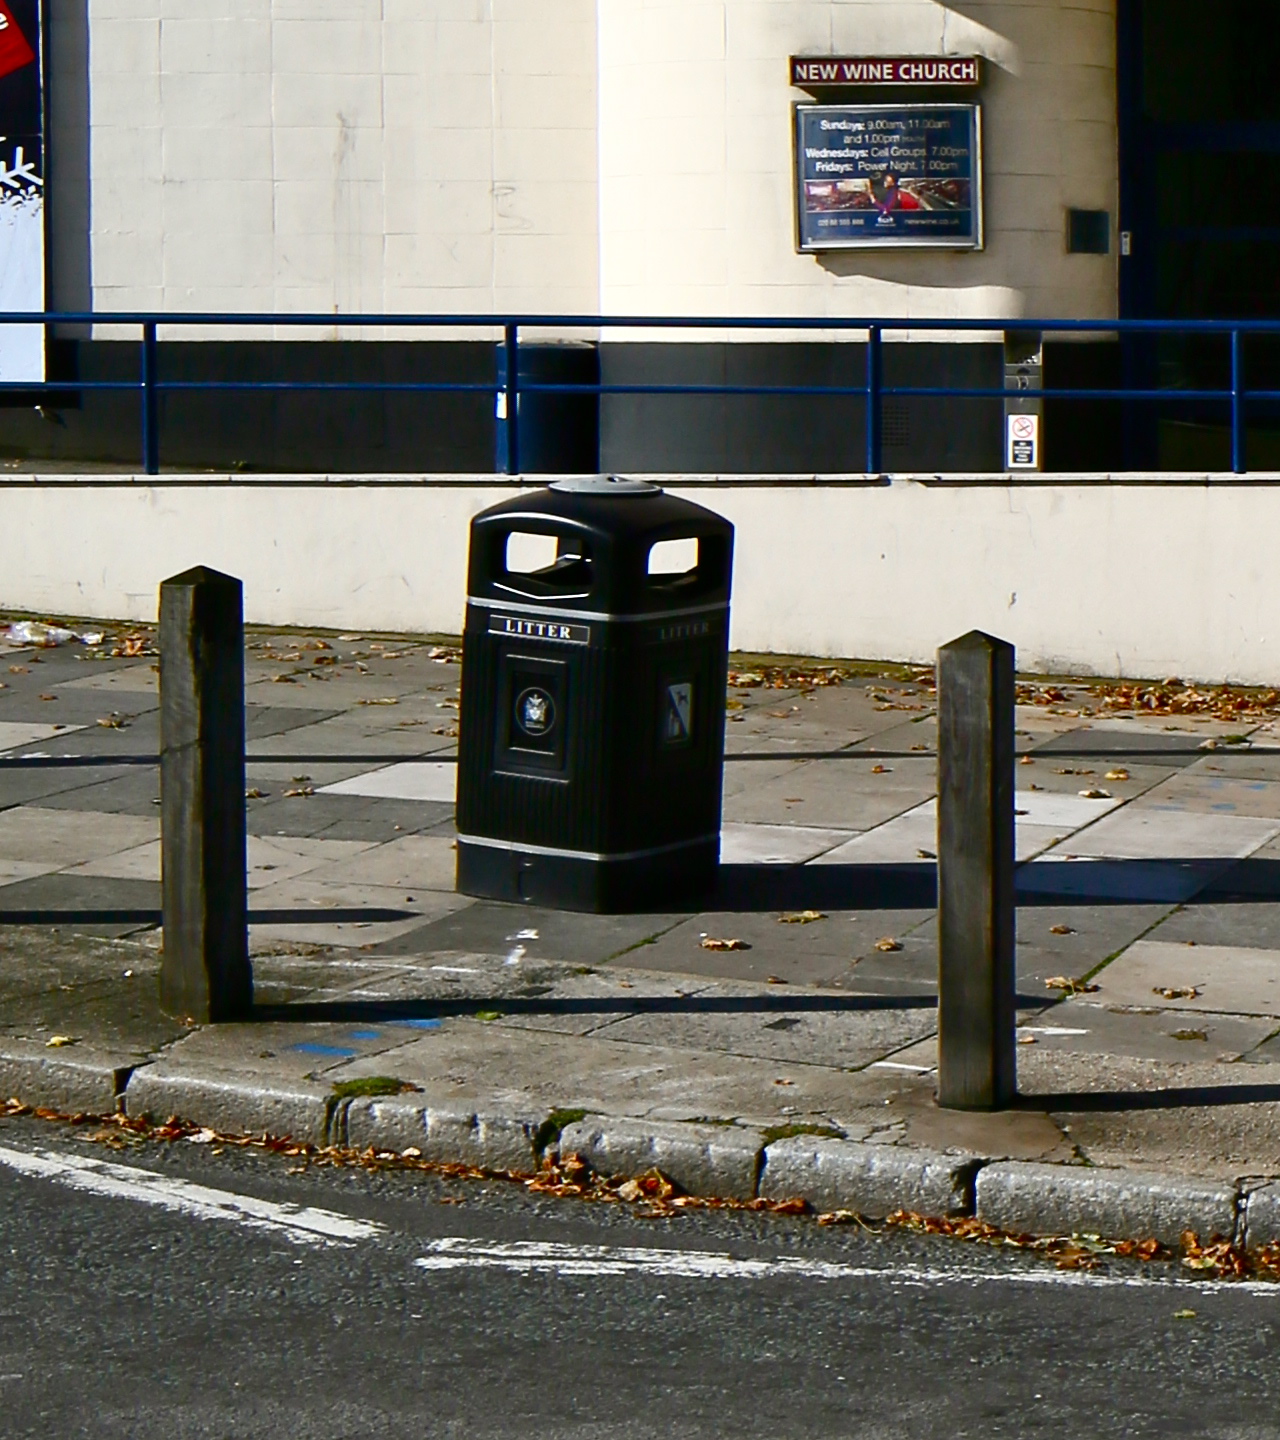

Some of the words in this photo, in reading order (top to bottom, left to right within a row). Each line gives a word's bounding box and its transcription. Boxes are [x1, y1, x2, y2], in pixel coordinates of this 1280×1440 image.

[795, 63, 838, 79] NEW
[843, 63, 894, 79] WINE
[899, 63, 975, 79] CHURCH
[820, 120, 866, 132] Sundays:
[844, 135, 862, 144] and
[805, 148, 869, 160] Wednesdays:
[815, 161, 854, 174] Fridays:
[857, 161, 889, 171] Power
[506, 618, 571, 639] LITTER
[661, 622, 710, 641] LITTER
